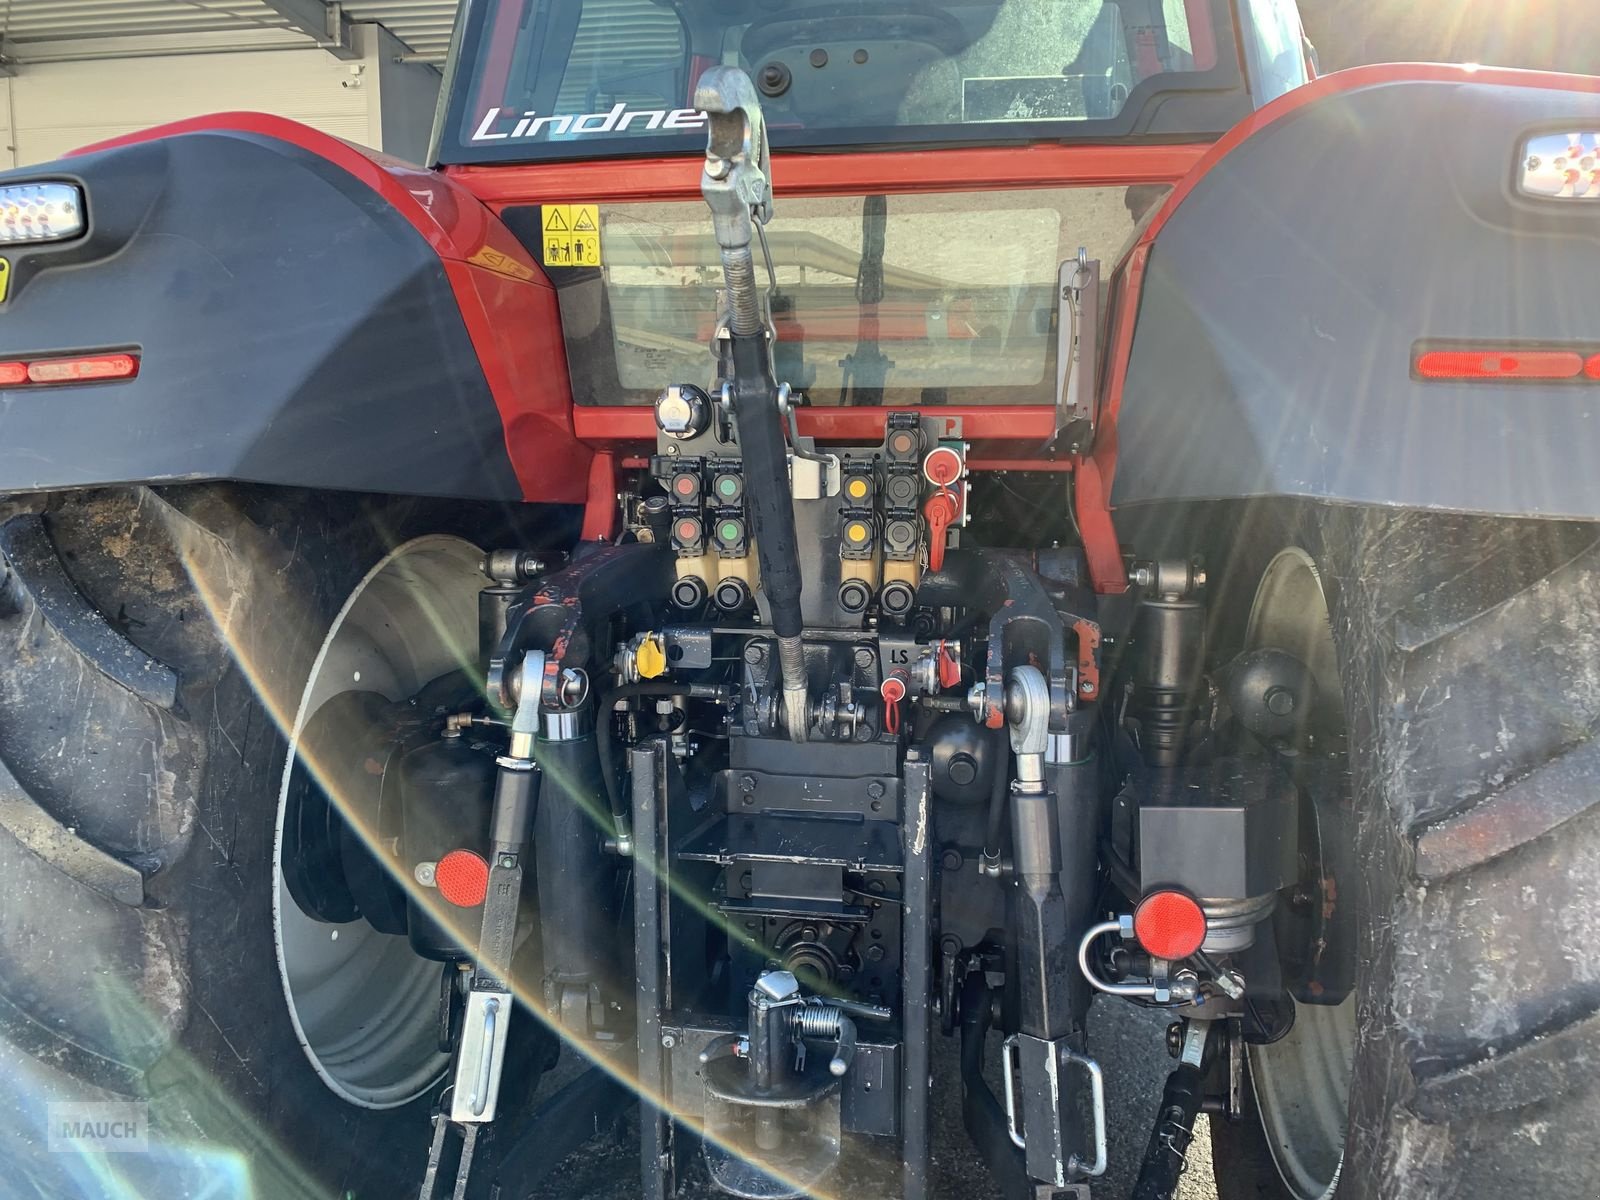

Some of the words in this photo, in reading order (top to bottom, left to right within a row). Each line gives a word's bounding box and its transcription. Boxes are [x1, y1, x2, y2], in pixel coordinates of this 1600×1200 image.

[472, 103, 708, 141] Lindne
[945, 419, 956, 436] P
[891, 649, 909, 665] LS
